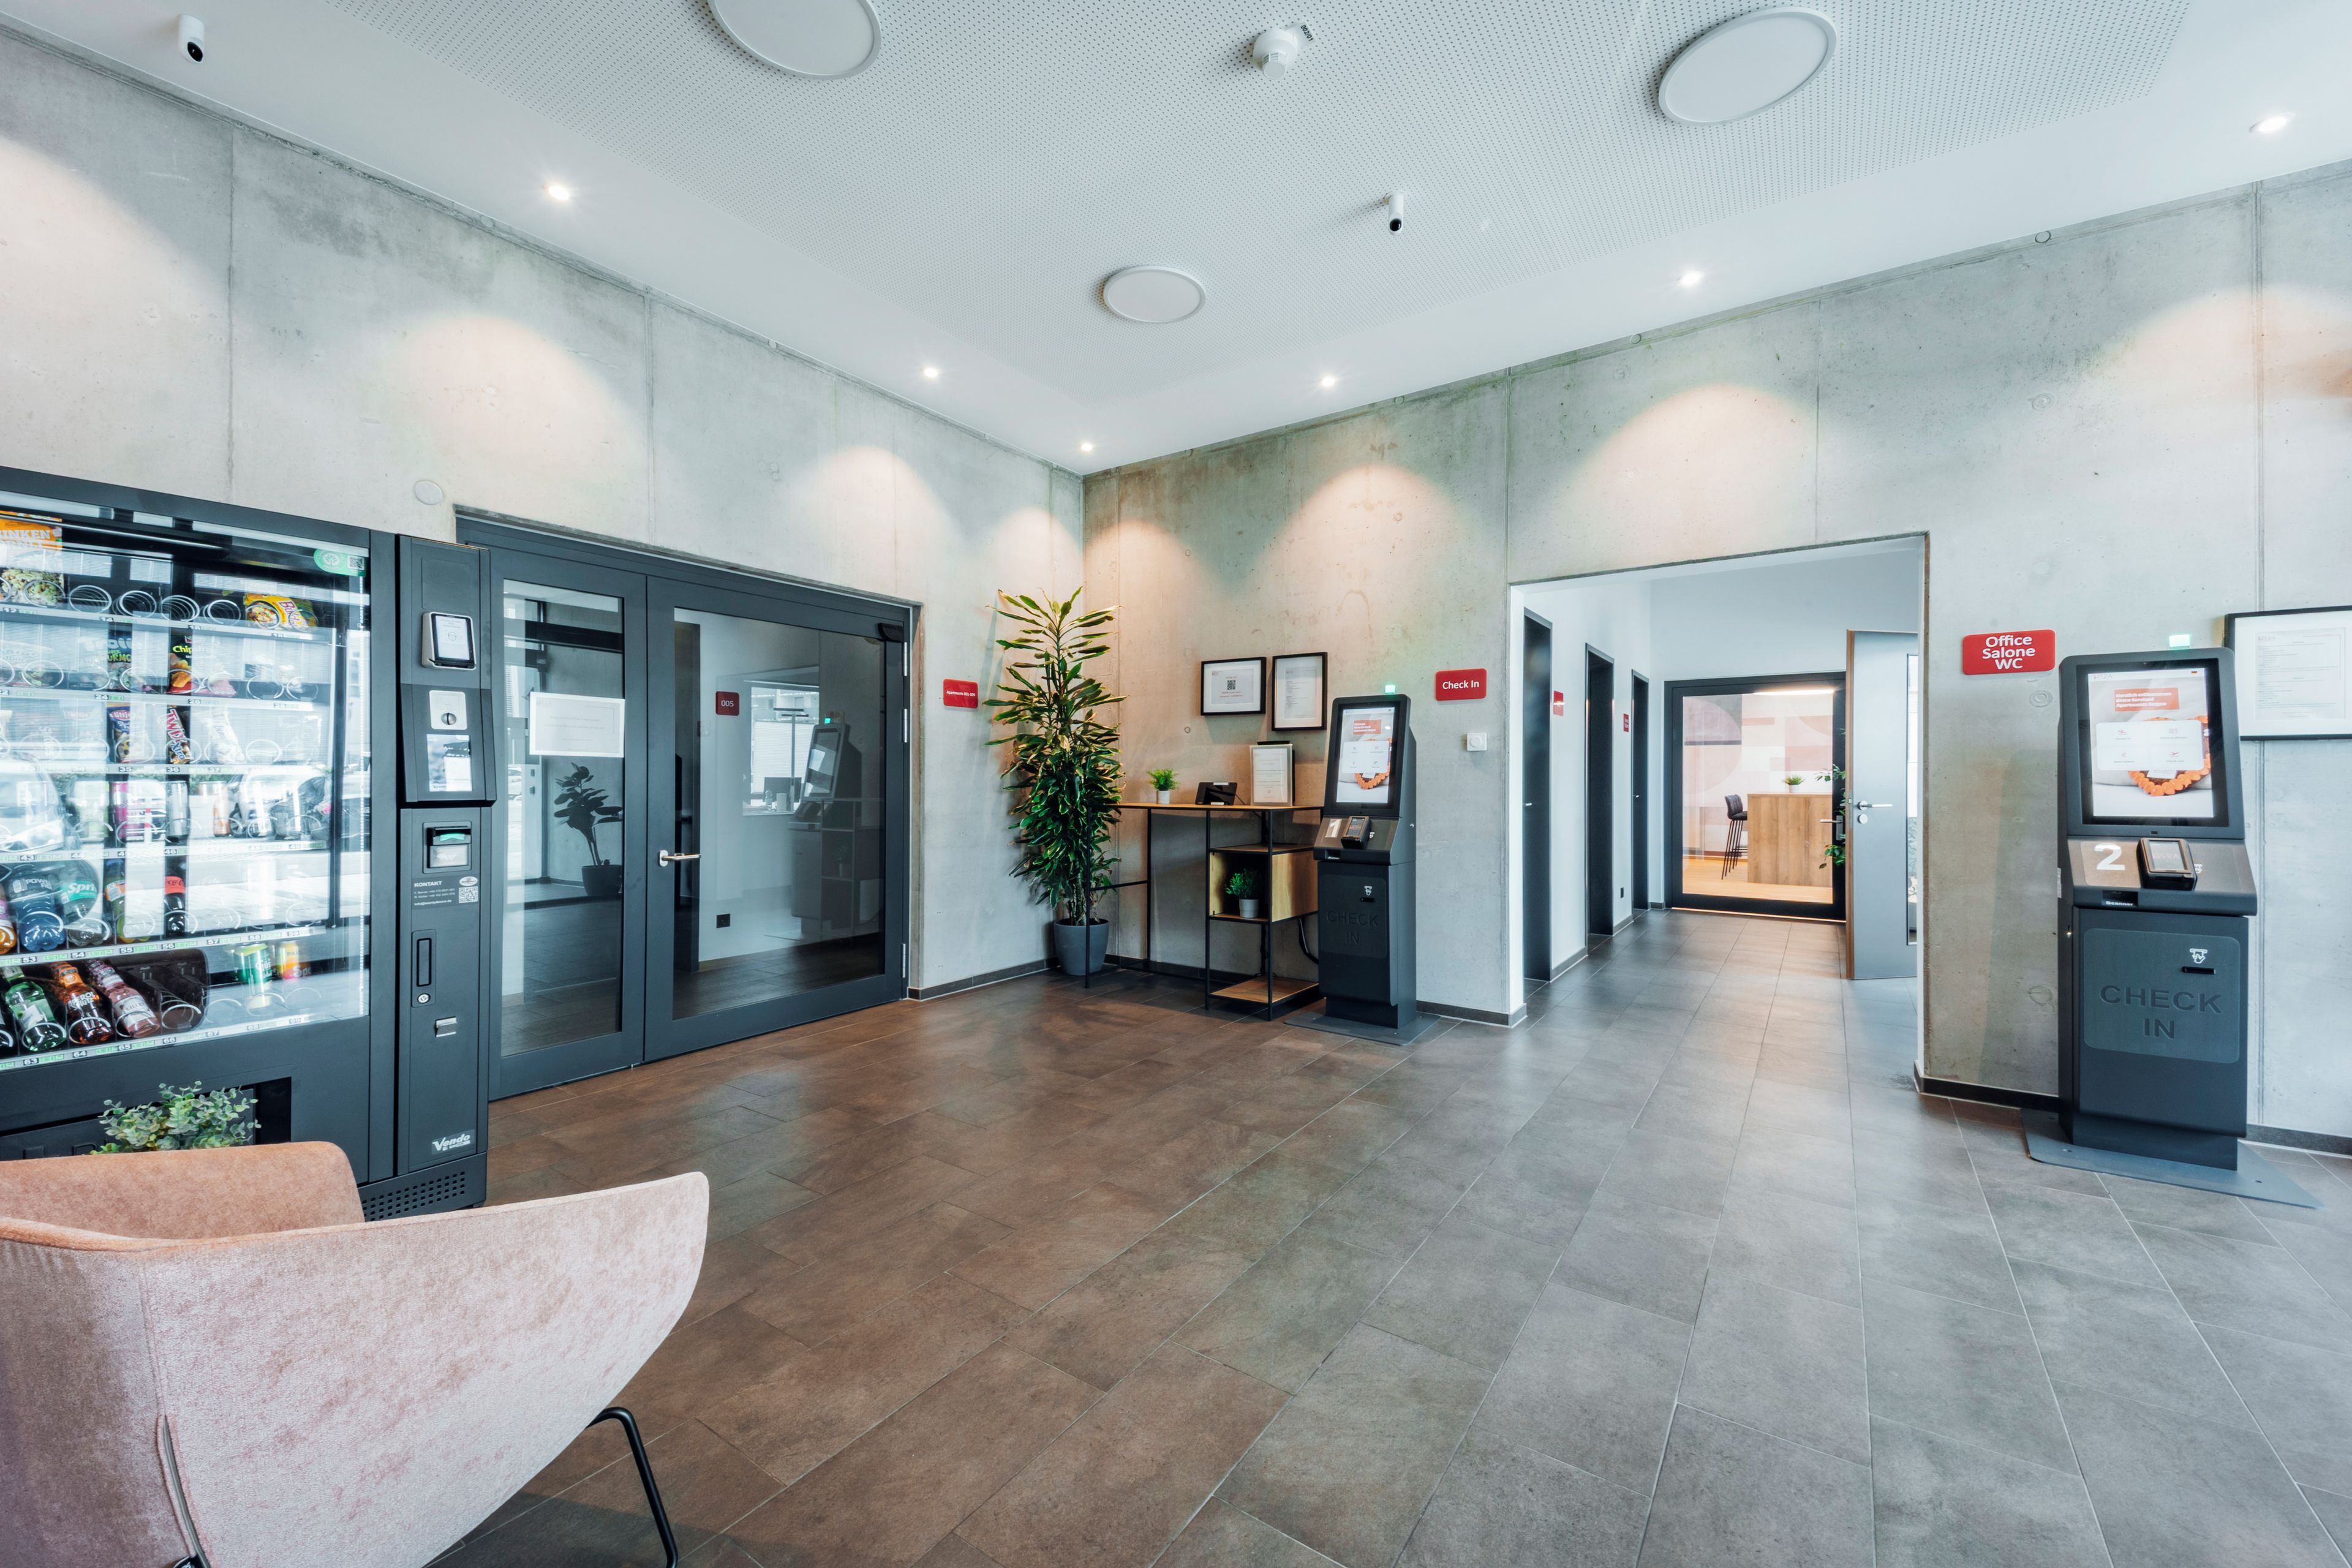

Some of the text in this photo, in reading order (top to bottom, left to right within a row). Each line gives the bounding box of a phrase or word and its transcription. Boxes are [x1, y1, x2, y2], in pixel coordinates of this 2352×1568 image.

[1986, 635, 2032, 647] Office
[1982, 647, 2035, 659] Salone
[1995, 658, 2023, 669] WC
[1442, 680, 1469, 690] Check
[1329, 818, 1342, 838] 1
[2094, 843, 2125, 870] 2
[68, 883, 96, 894] Spri
[1326, 911, 1379, 927] CHECK
[1346, 931, 1360, 944] IN
[2100, 985, 2222, 1014] CHECK
[2144, 1018, 2174, 1039] IN
[432, 1134, 470, 1151] Vendo
